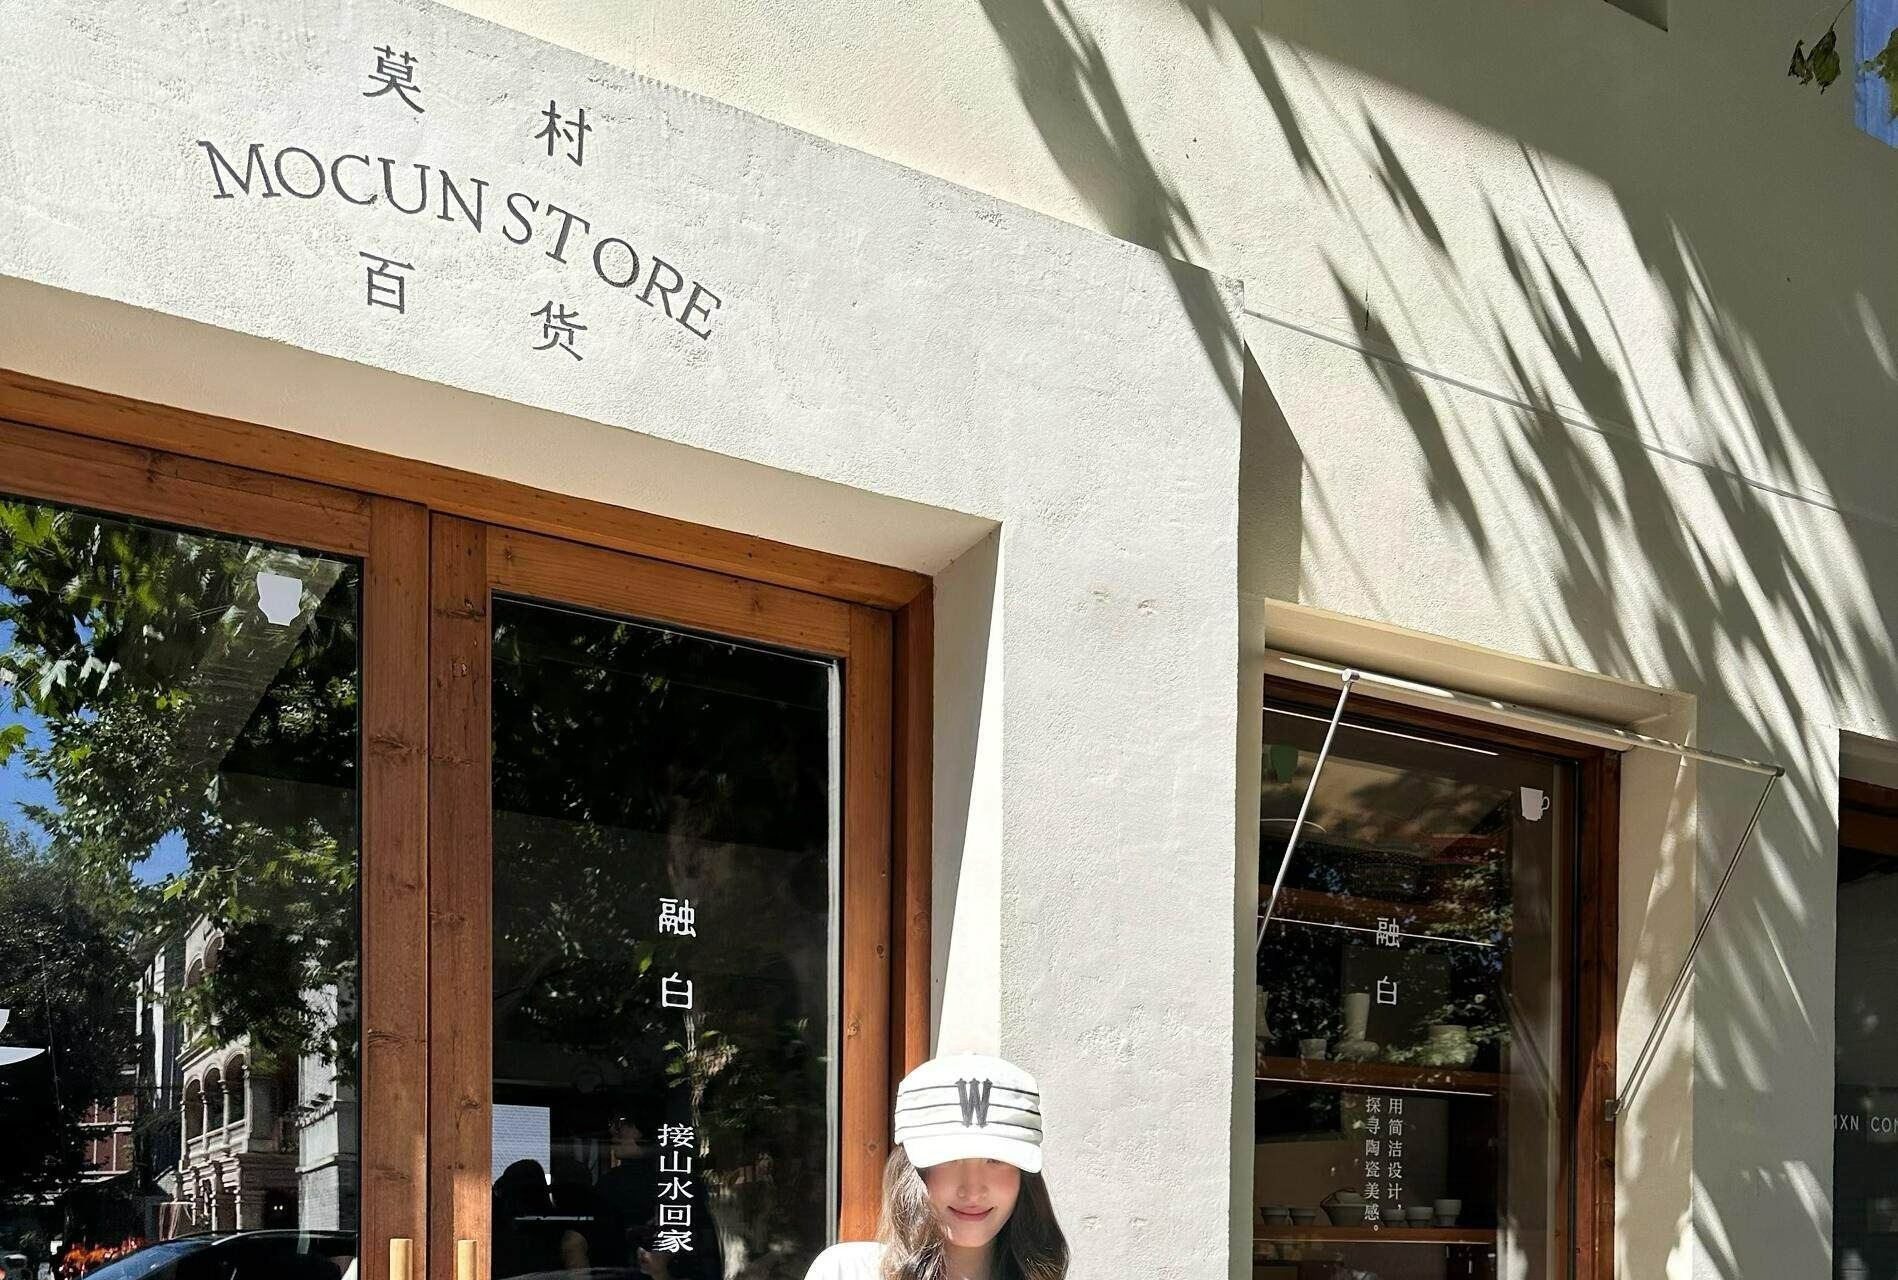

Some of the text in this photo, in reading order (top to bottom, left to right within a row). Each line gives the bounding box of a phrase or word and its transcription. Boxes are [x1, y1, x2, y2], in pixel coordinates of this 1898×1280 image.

[197, 140, 722, 341] MOCUN STORE
[955, 1078, 993, 1128] W
[1834, 1114, 1859, 1130] XN
[656, 1123, 694, 1253] 接山水回家
